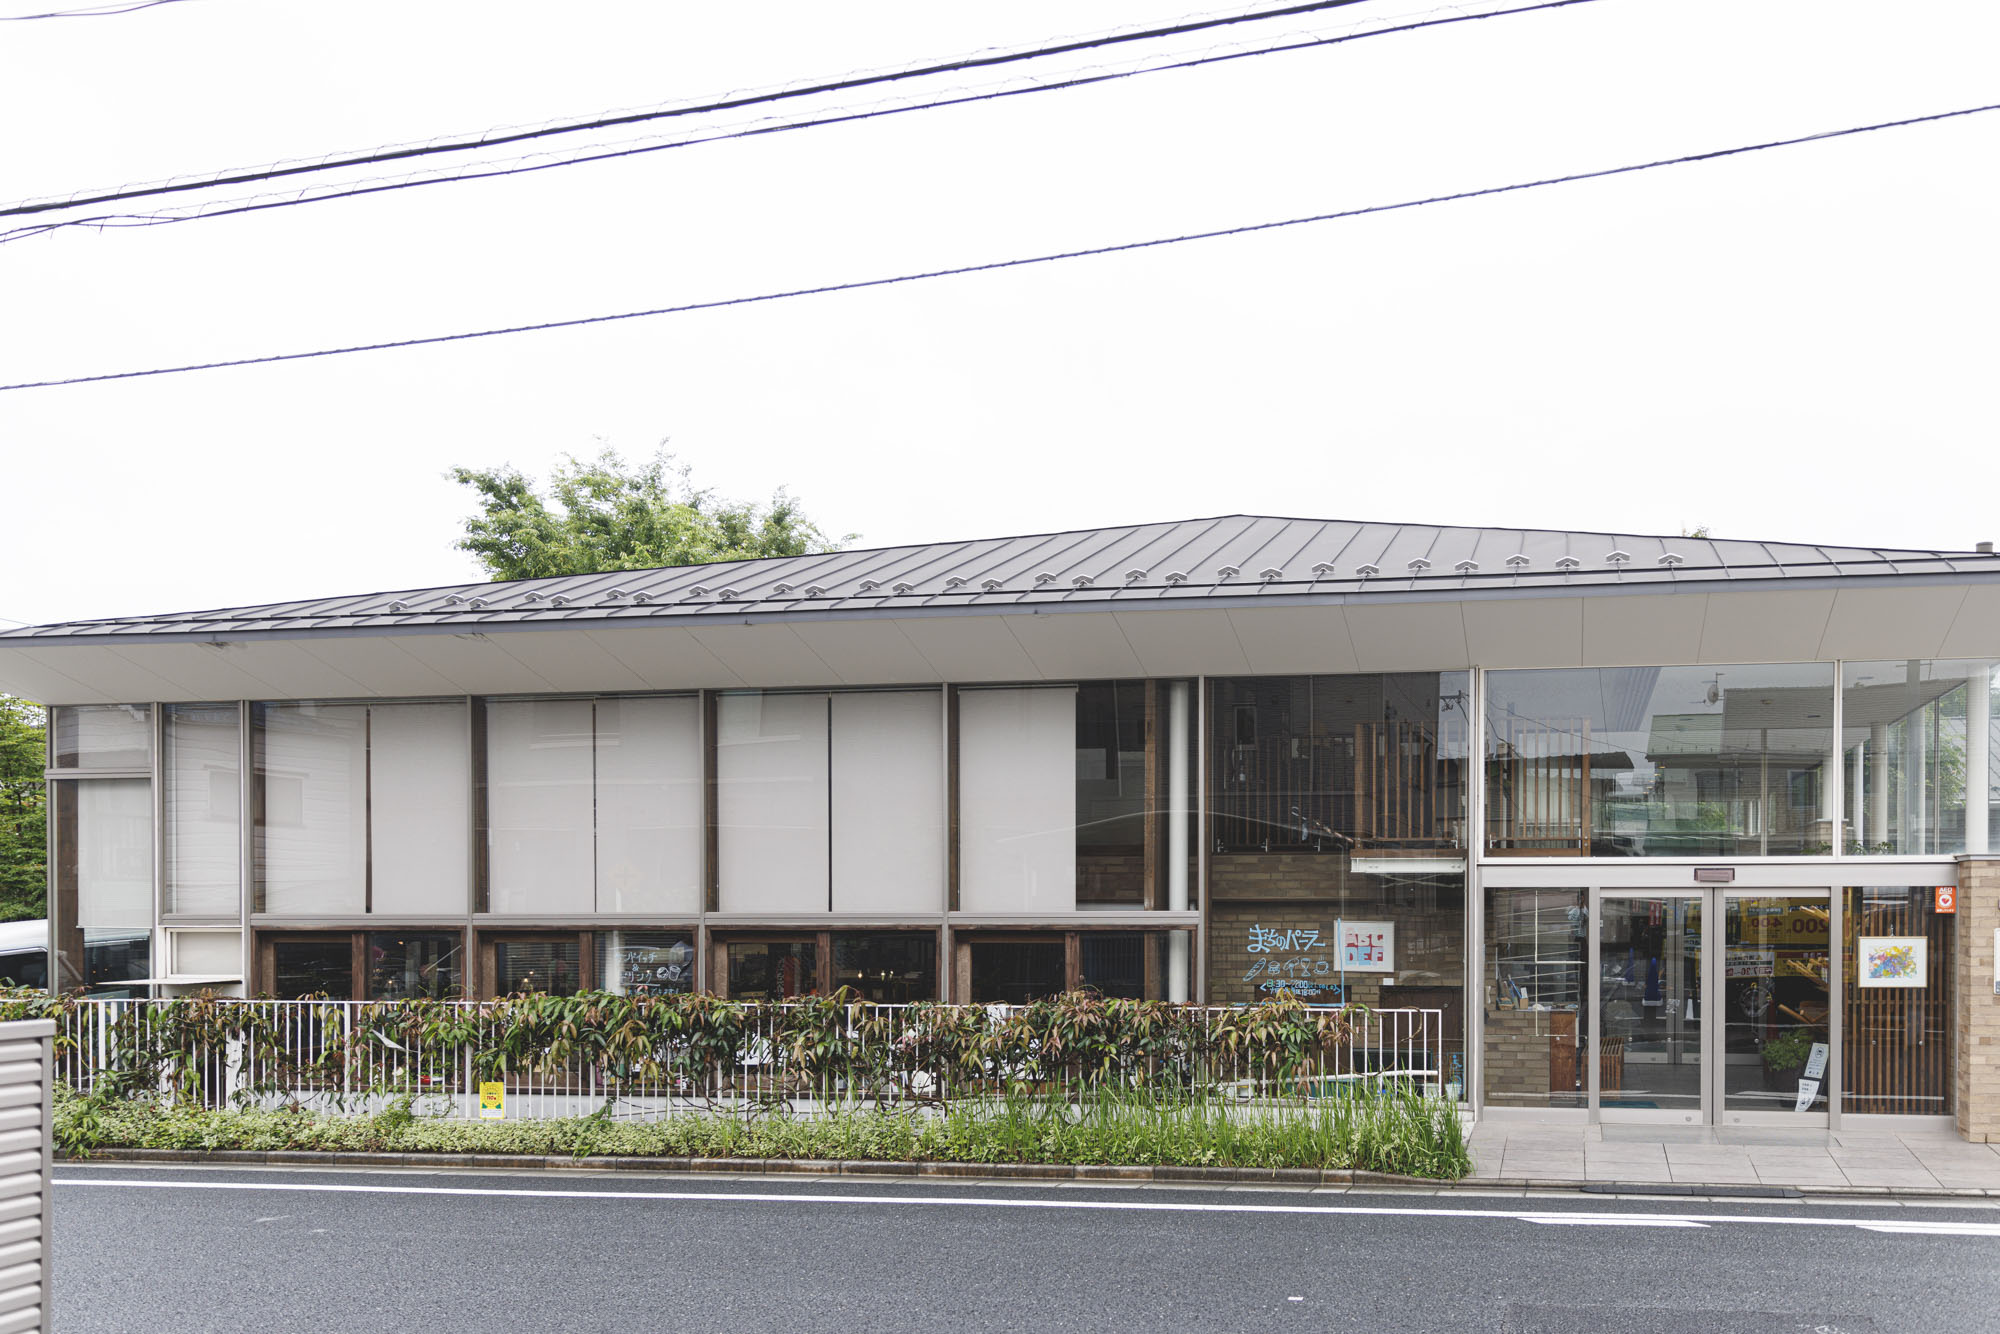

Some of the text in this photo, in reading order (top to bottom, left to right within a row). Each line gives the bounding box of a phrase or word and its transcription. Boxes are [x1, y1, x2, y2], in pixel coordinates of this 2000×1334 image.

[1247, 923, 1326, 953] まちのパーラー
[1345, 946, 1384, 966] DEF
